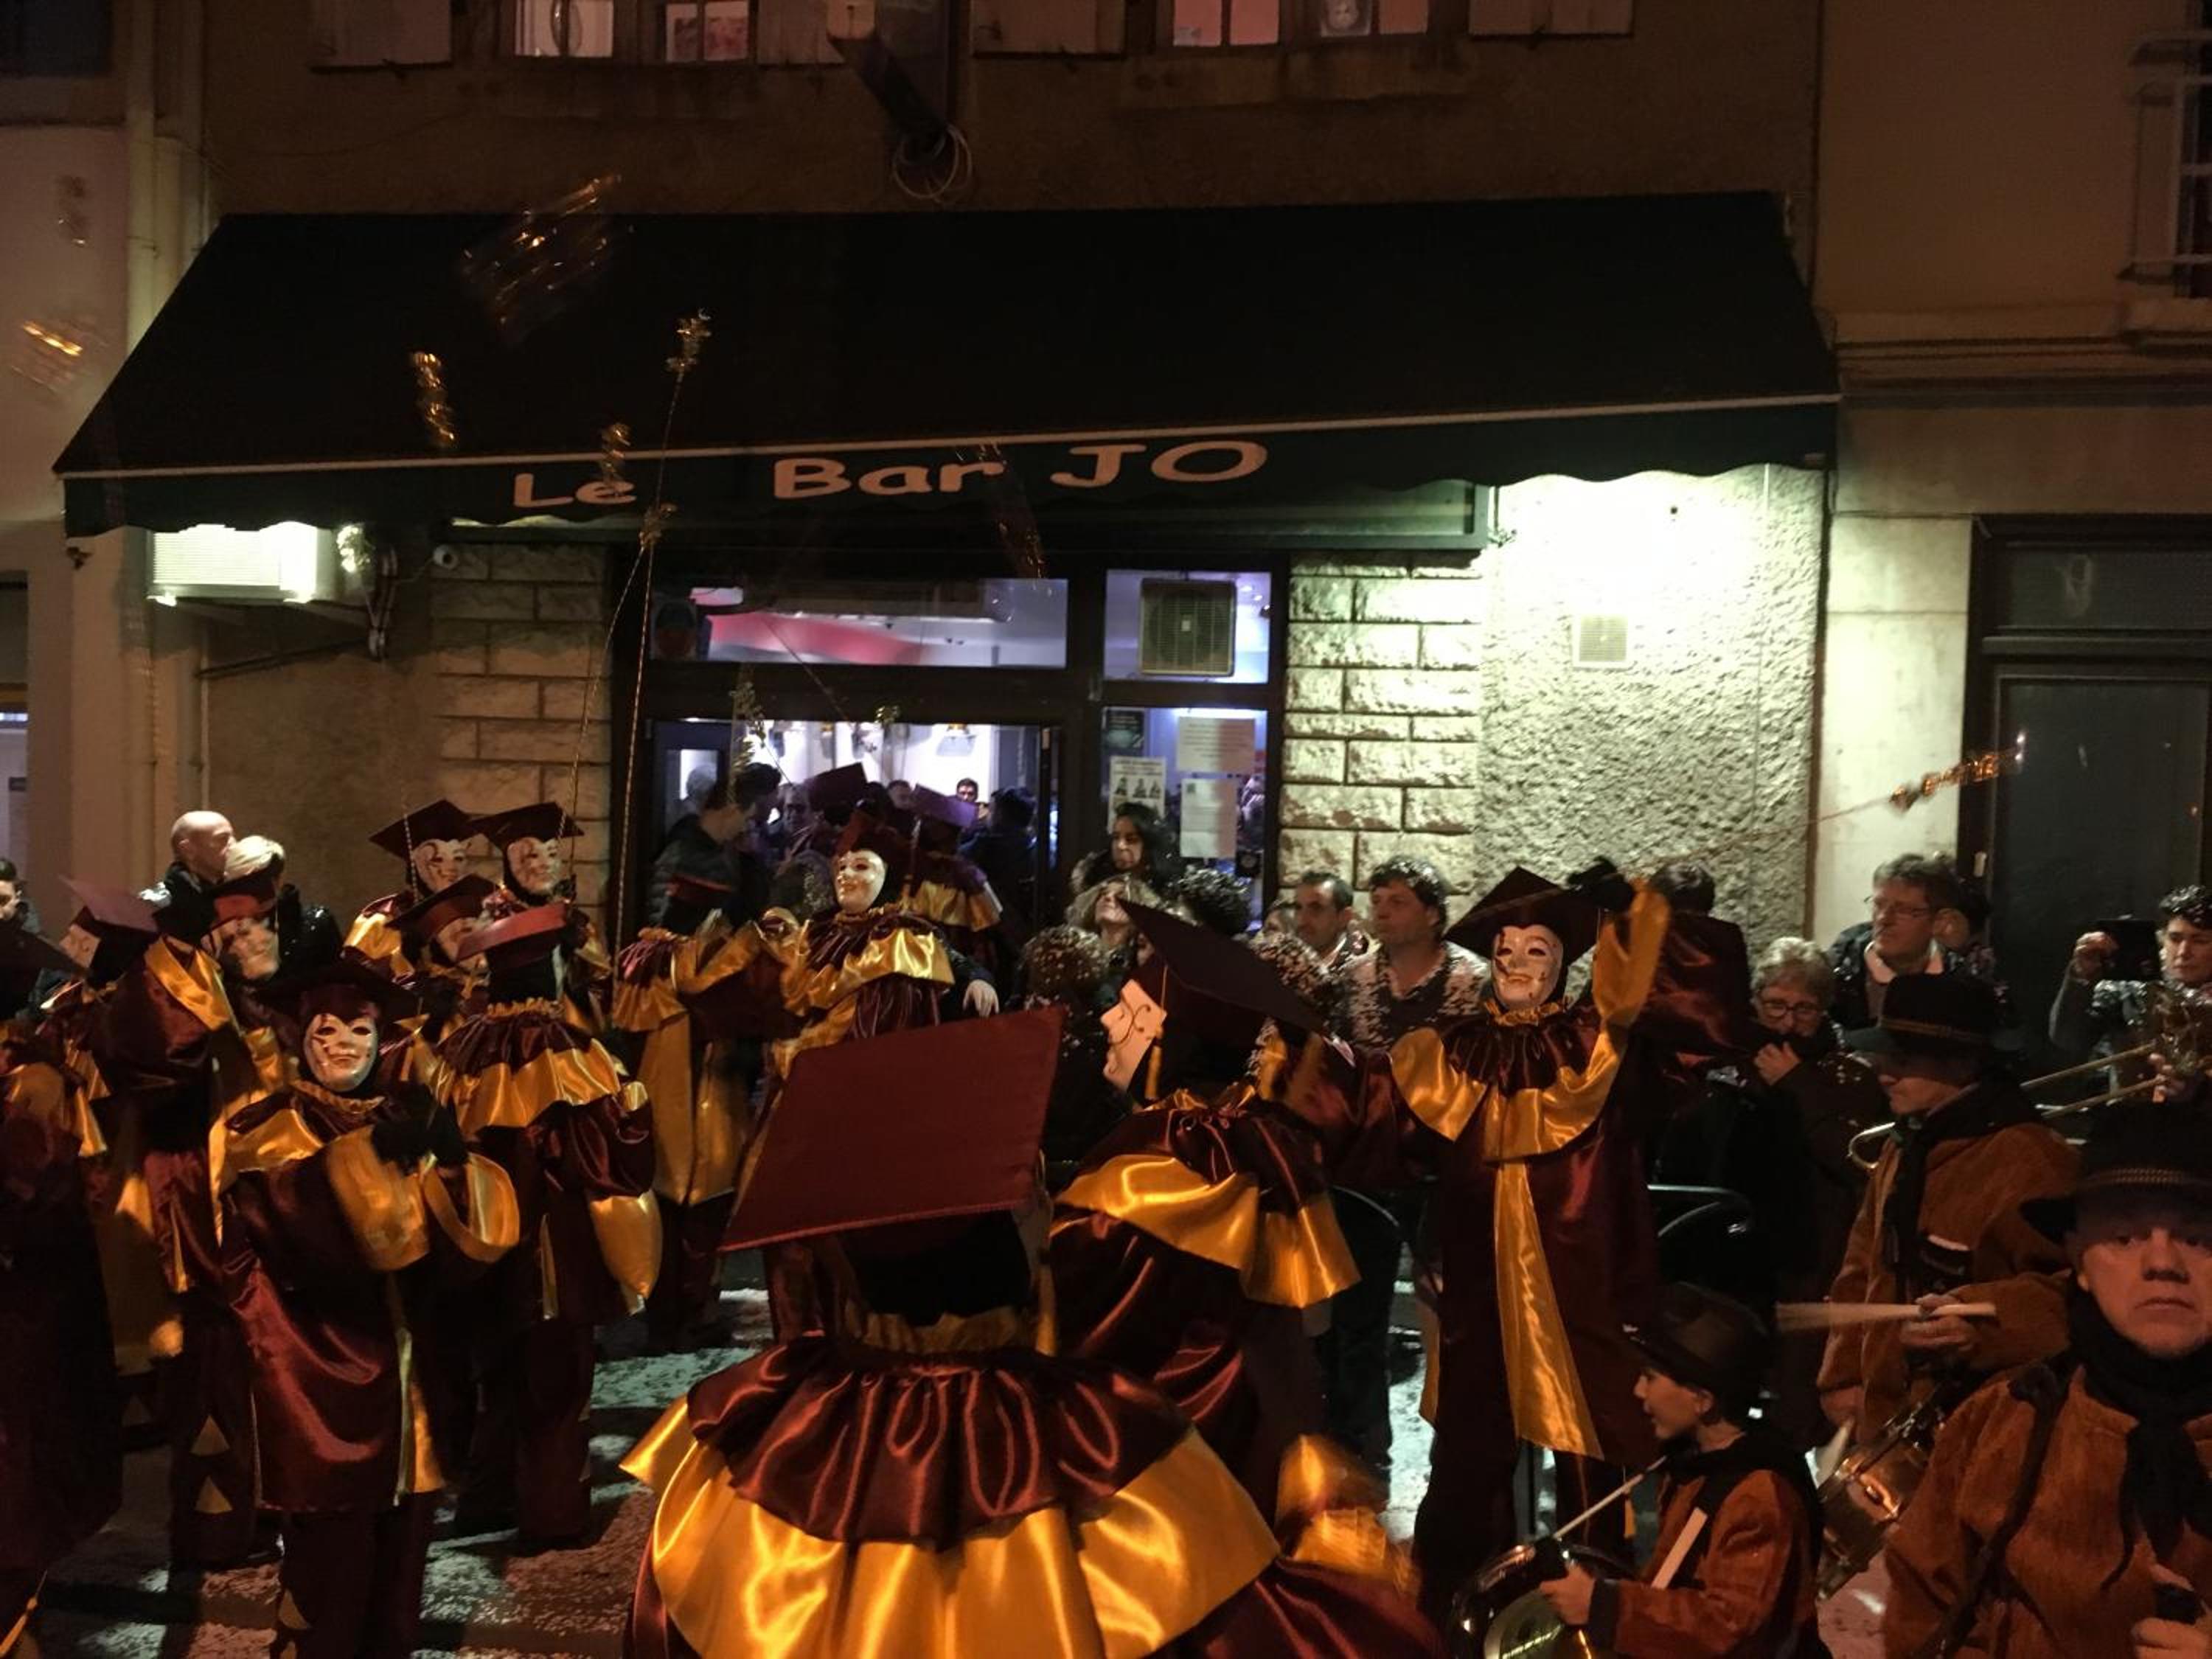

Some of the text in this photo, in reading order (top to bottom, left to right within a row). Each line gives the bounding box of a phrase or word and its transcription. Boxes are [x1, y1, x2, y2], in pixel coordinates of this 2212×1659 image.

[513, 439, 1268, 509] Le Bar JO
